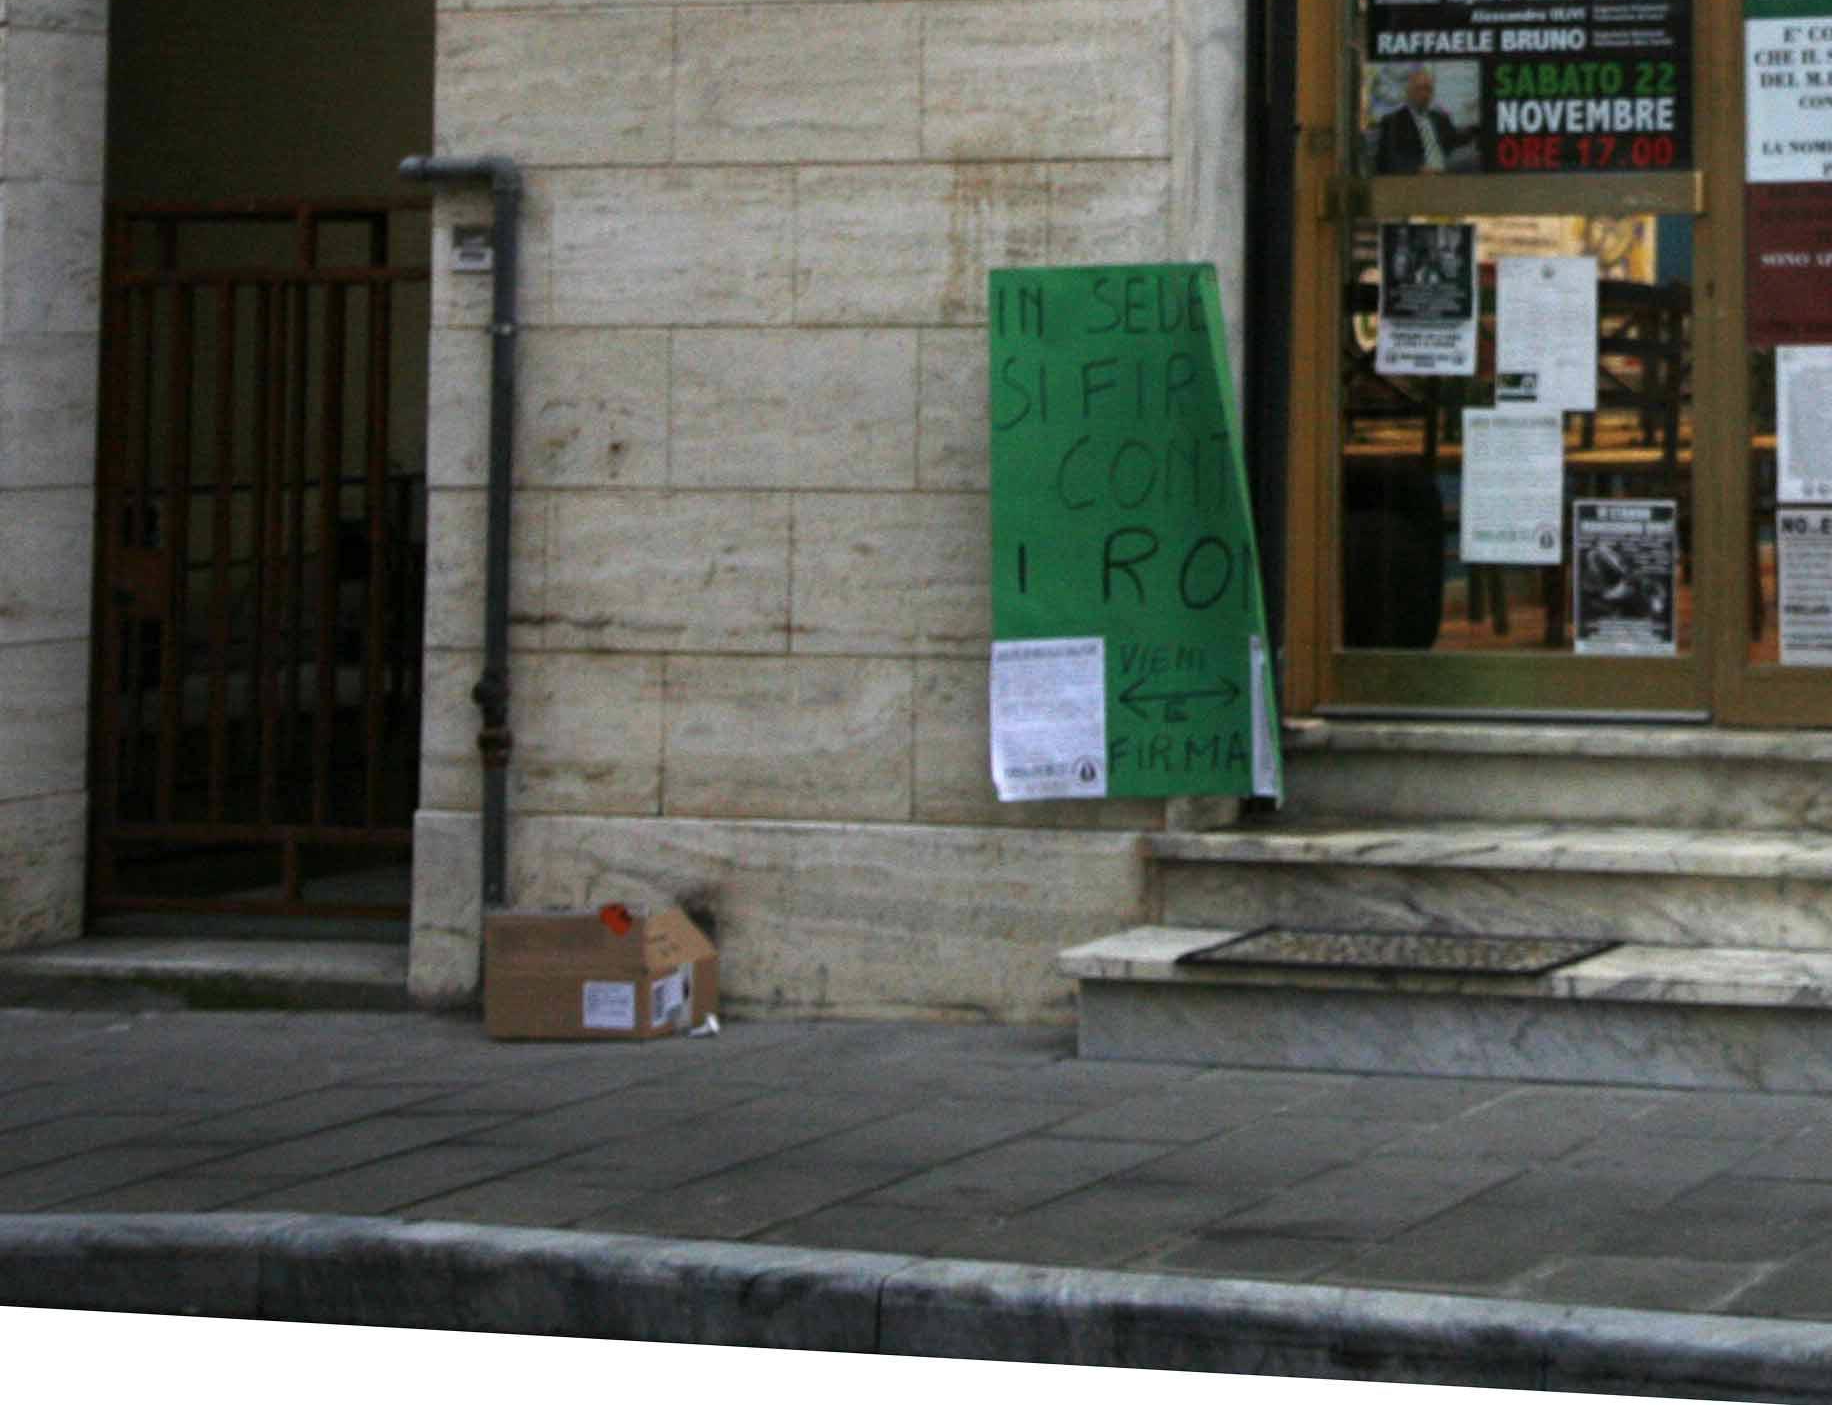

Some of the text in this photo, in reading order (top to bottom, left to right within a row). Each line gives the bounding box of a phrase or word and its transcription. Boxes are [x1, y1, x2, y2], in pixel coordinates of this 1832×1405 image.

[1377, 30, 1494, 55] RAFFAELE
[1501, 28, 1586, 53] BRUNO
[1754, 49, 1793, 67] CHE
[1495, 62, 1678, 95] SABATO 22
[1760, 72, 1798, 89] DEL
[1497, 98, 1675, 133] NOVEMBRE
[1497, 136, 1676, 169] ORE 17.00
[992, 355, 1047, 433] SI
[1781, 516, 1808, 535] NO
